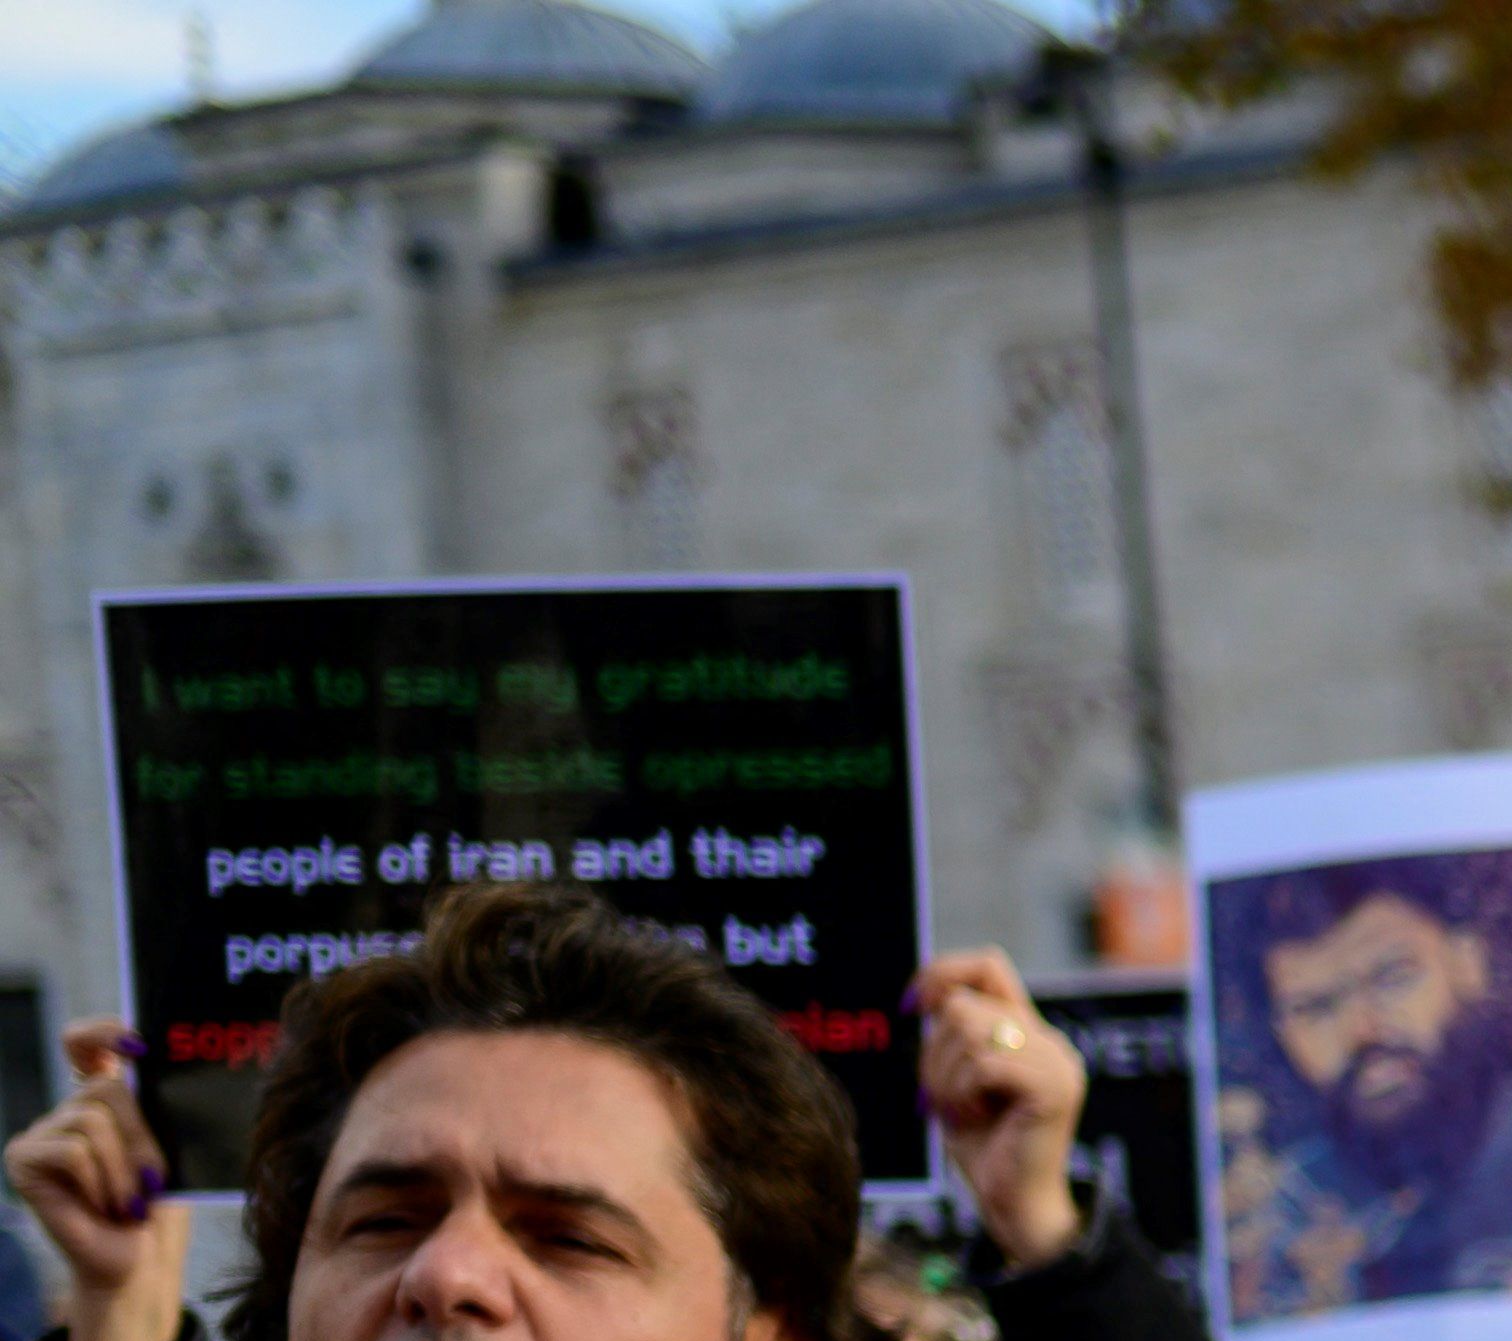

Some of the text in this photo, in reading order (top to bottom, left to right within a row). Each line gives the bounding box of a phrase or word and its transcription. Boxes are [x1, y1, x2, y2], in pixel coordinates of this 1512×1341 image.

[173, 664, 294, 713] want
[313, 660, 365, 709] to
[381, 664, 479, 715] say
[599, 650, 850, 713] gratitude
[222, 746, 442, 804] standing
[207, 833, 361, 897] people
[378, 829, 430, 885] of
[448, 828, 553, 881] iran
[572, 822, 673, 880] and
[723, 912, 817, 967] but
